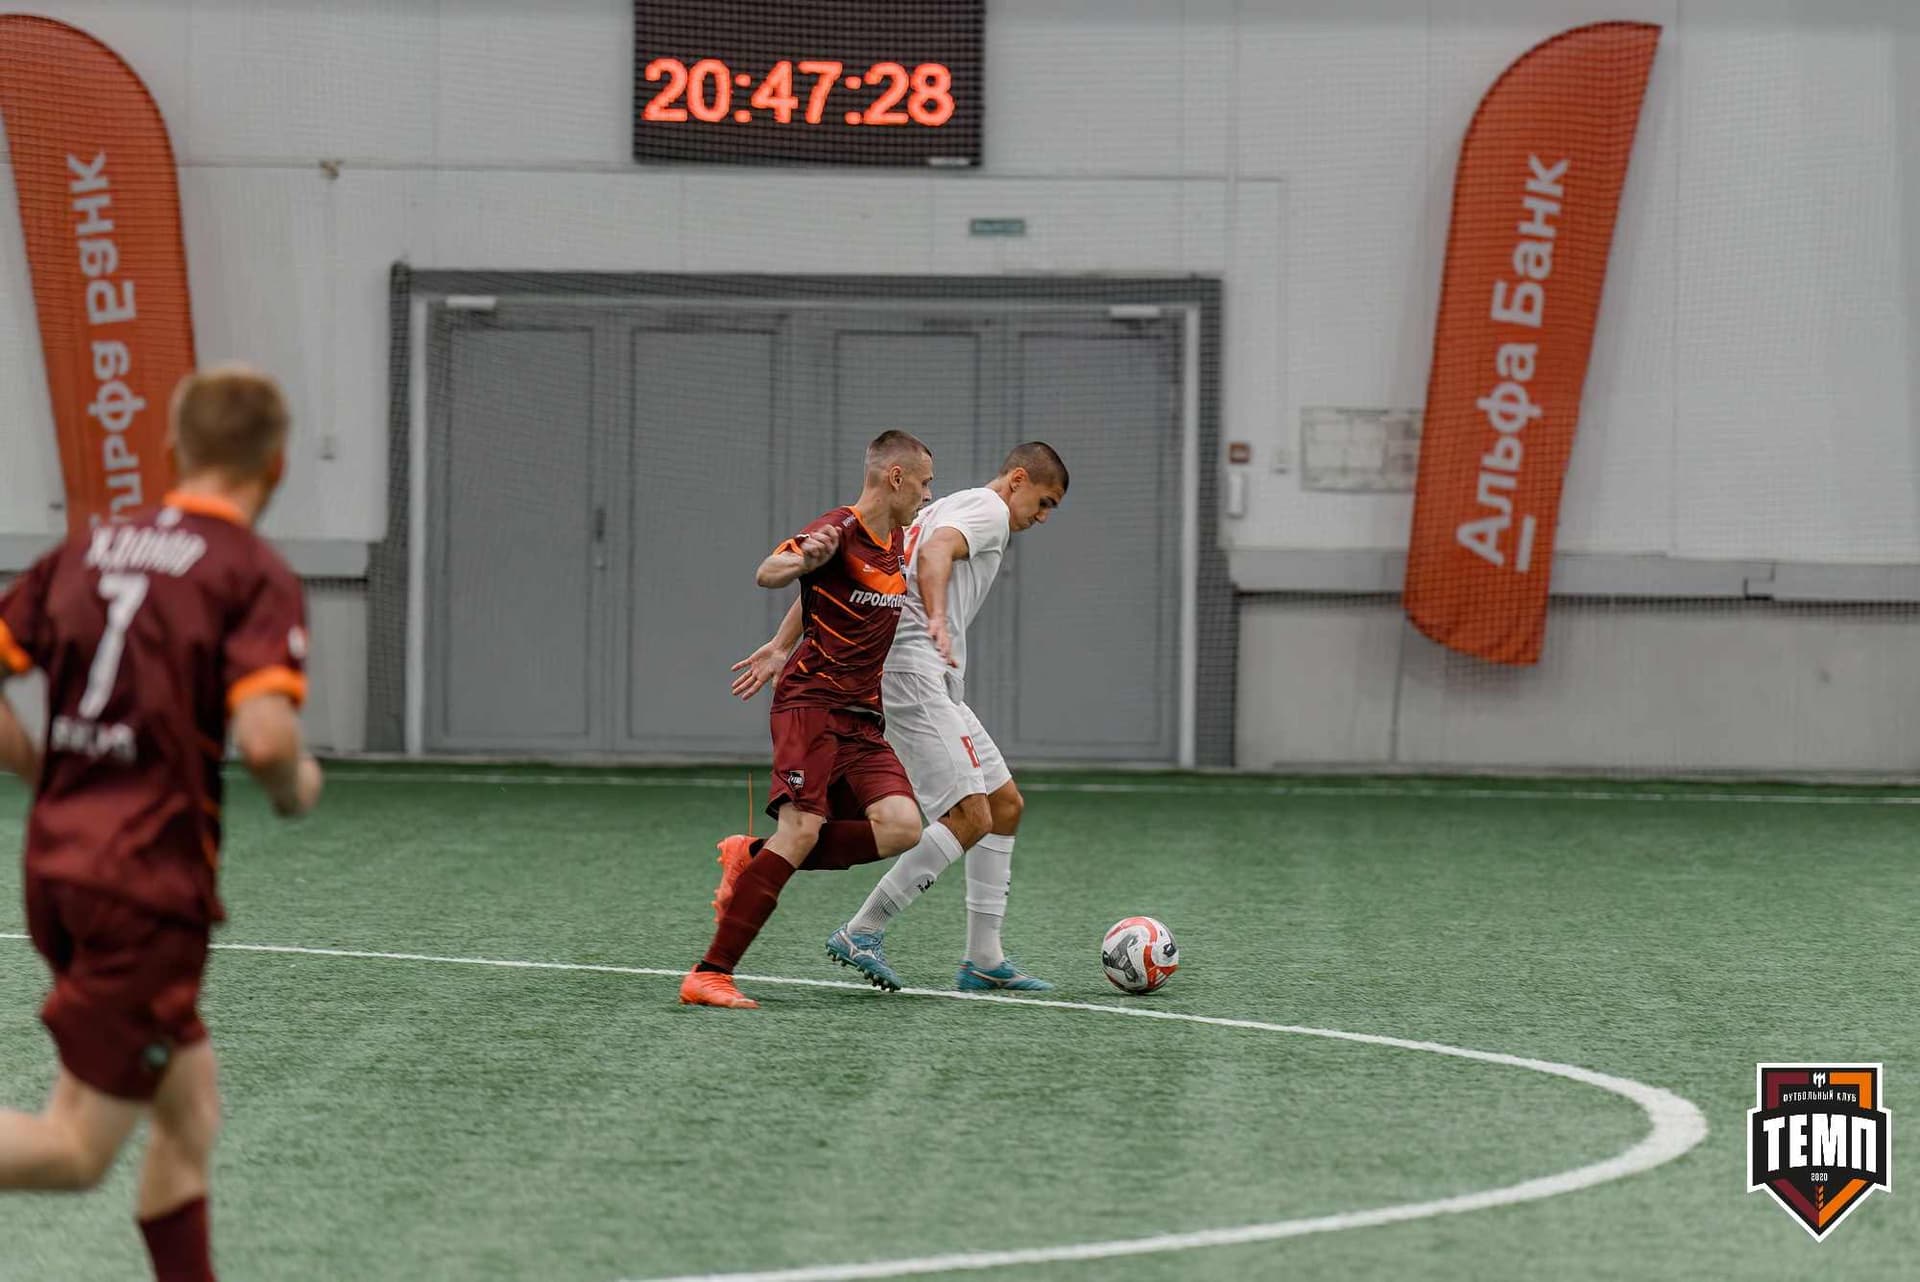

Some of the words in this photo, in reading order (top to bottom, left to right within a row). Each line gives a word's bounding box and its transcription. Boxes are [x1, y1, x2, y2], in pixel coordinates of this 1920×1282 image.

[641, 57, 956, 127] 20:47:28
[1490, 153, 1569, 328] Банк
[1456, 342, 1544, 567] Альфа
[79, 572, 149, 718] 7
